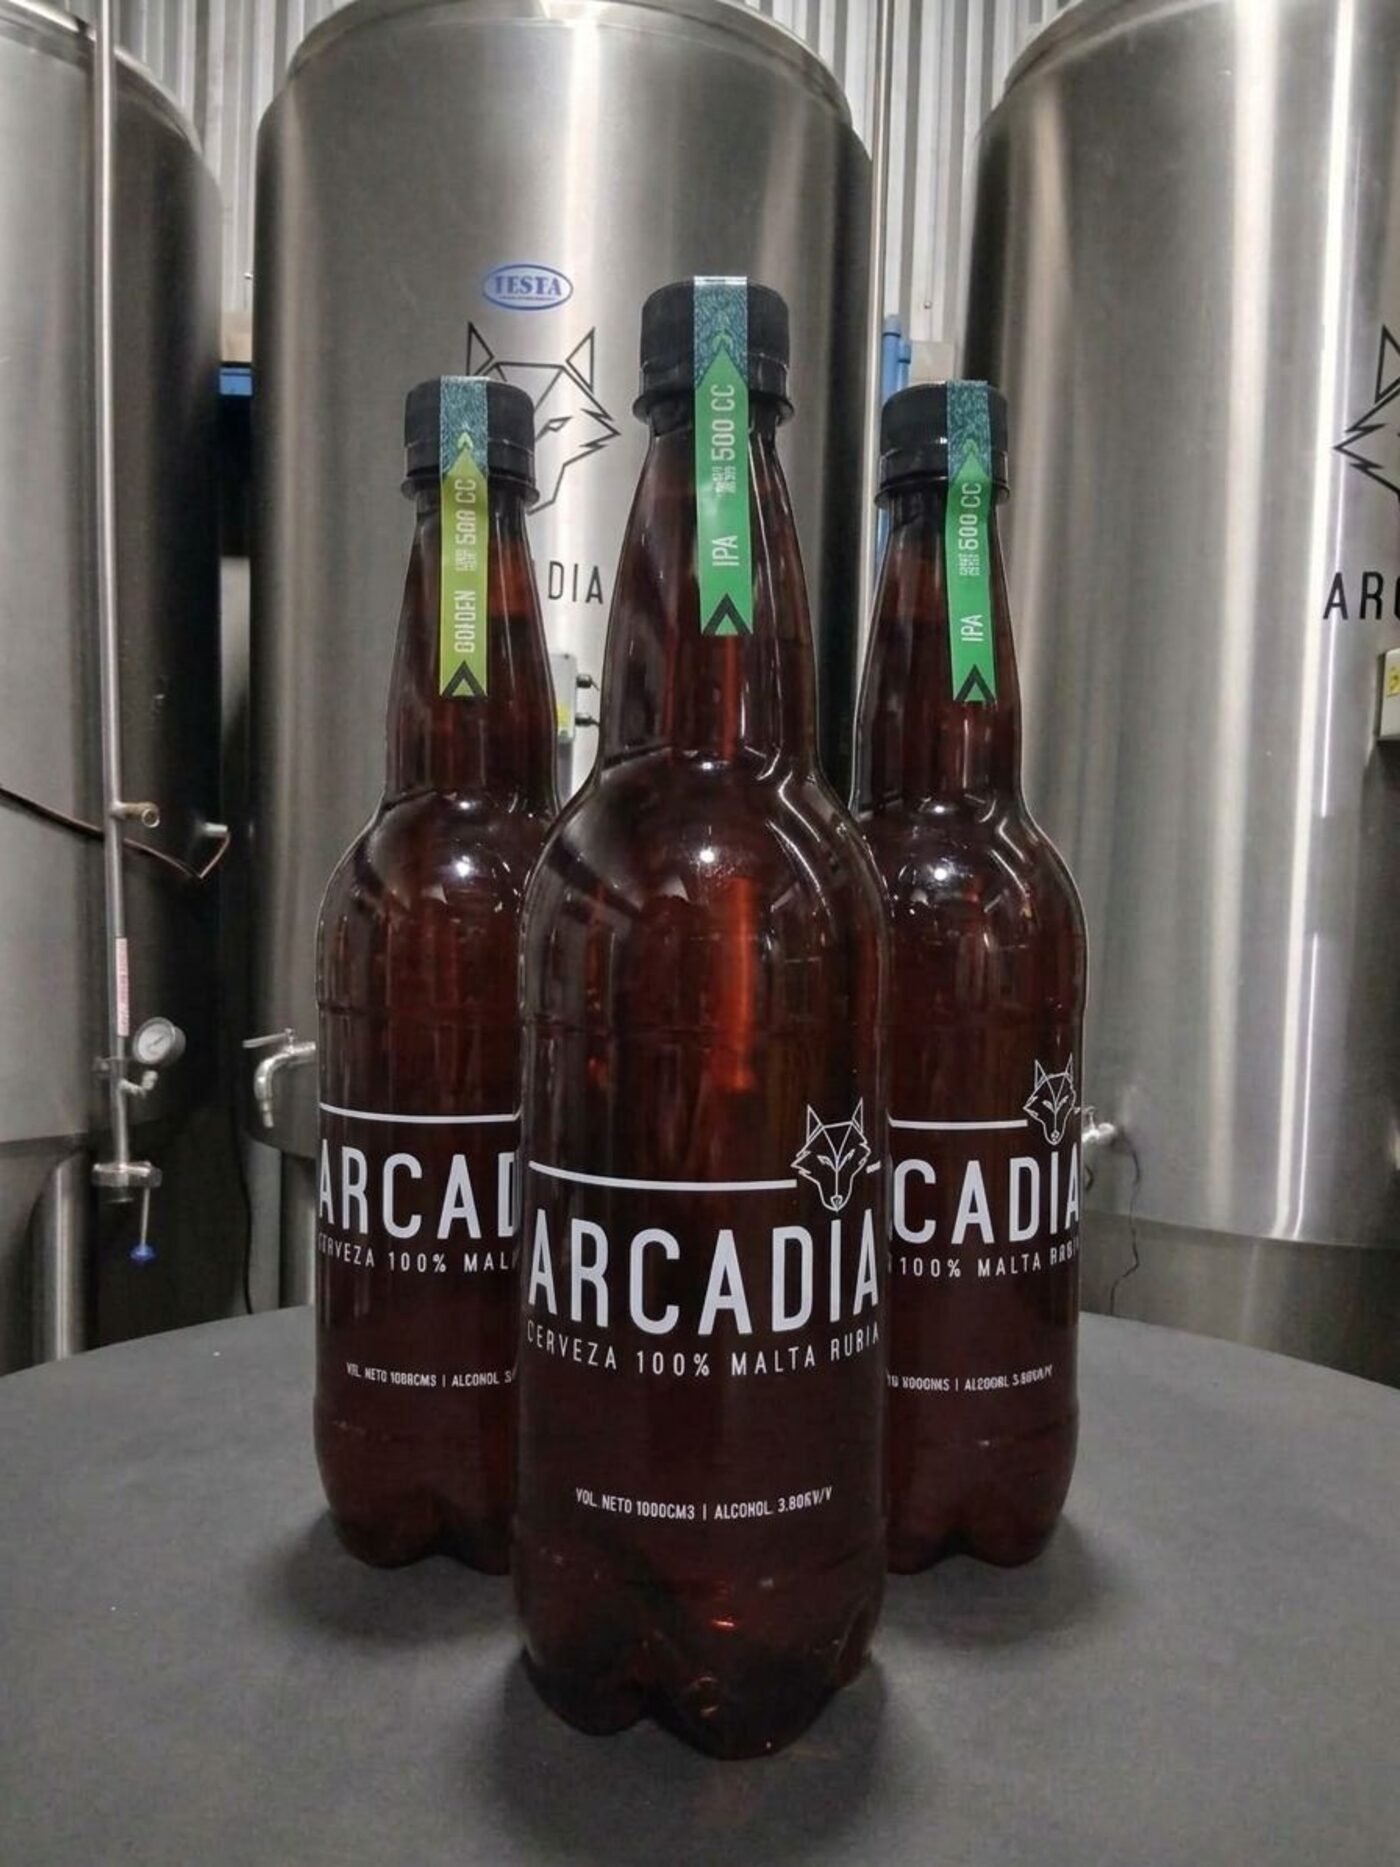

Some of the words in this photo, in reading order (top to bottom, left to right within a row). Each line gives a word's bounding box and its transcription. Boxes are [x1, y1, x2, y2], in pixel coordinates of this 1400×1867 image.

[711, 384, 736, 416] CC
[711, 419, 736, 461] 500
[454, 478, 477, 503] CC
[960, 482, 982, 508] CC
[455, 510, 477, 545] 500
[958, 513, 980, 550] 500
[712, 535, 739, 567] IPA
[960, 614, 984, 642] IPA
[388, 1251, 446, 1273] 100%
[528, 1208, 879, 1336] ARCADIA
[900, 1256, 961, 1278] 100%
[977, 1252, 1042, 1278] MALTA
[527, 1319, 618, 1371] CERVEZA
[636, 1351, 710, 1377] 100%
[731, 1344, 816, 1377] MALTA
[830, 1320, 880, 1362] RUBIA
[602, 1494, 633, 1514] NETO
[636, 1501, 696, 1521] 1000CM3
